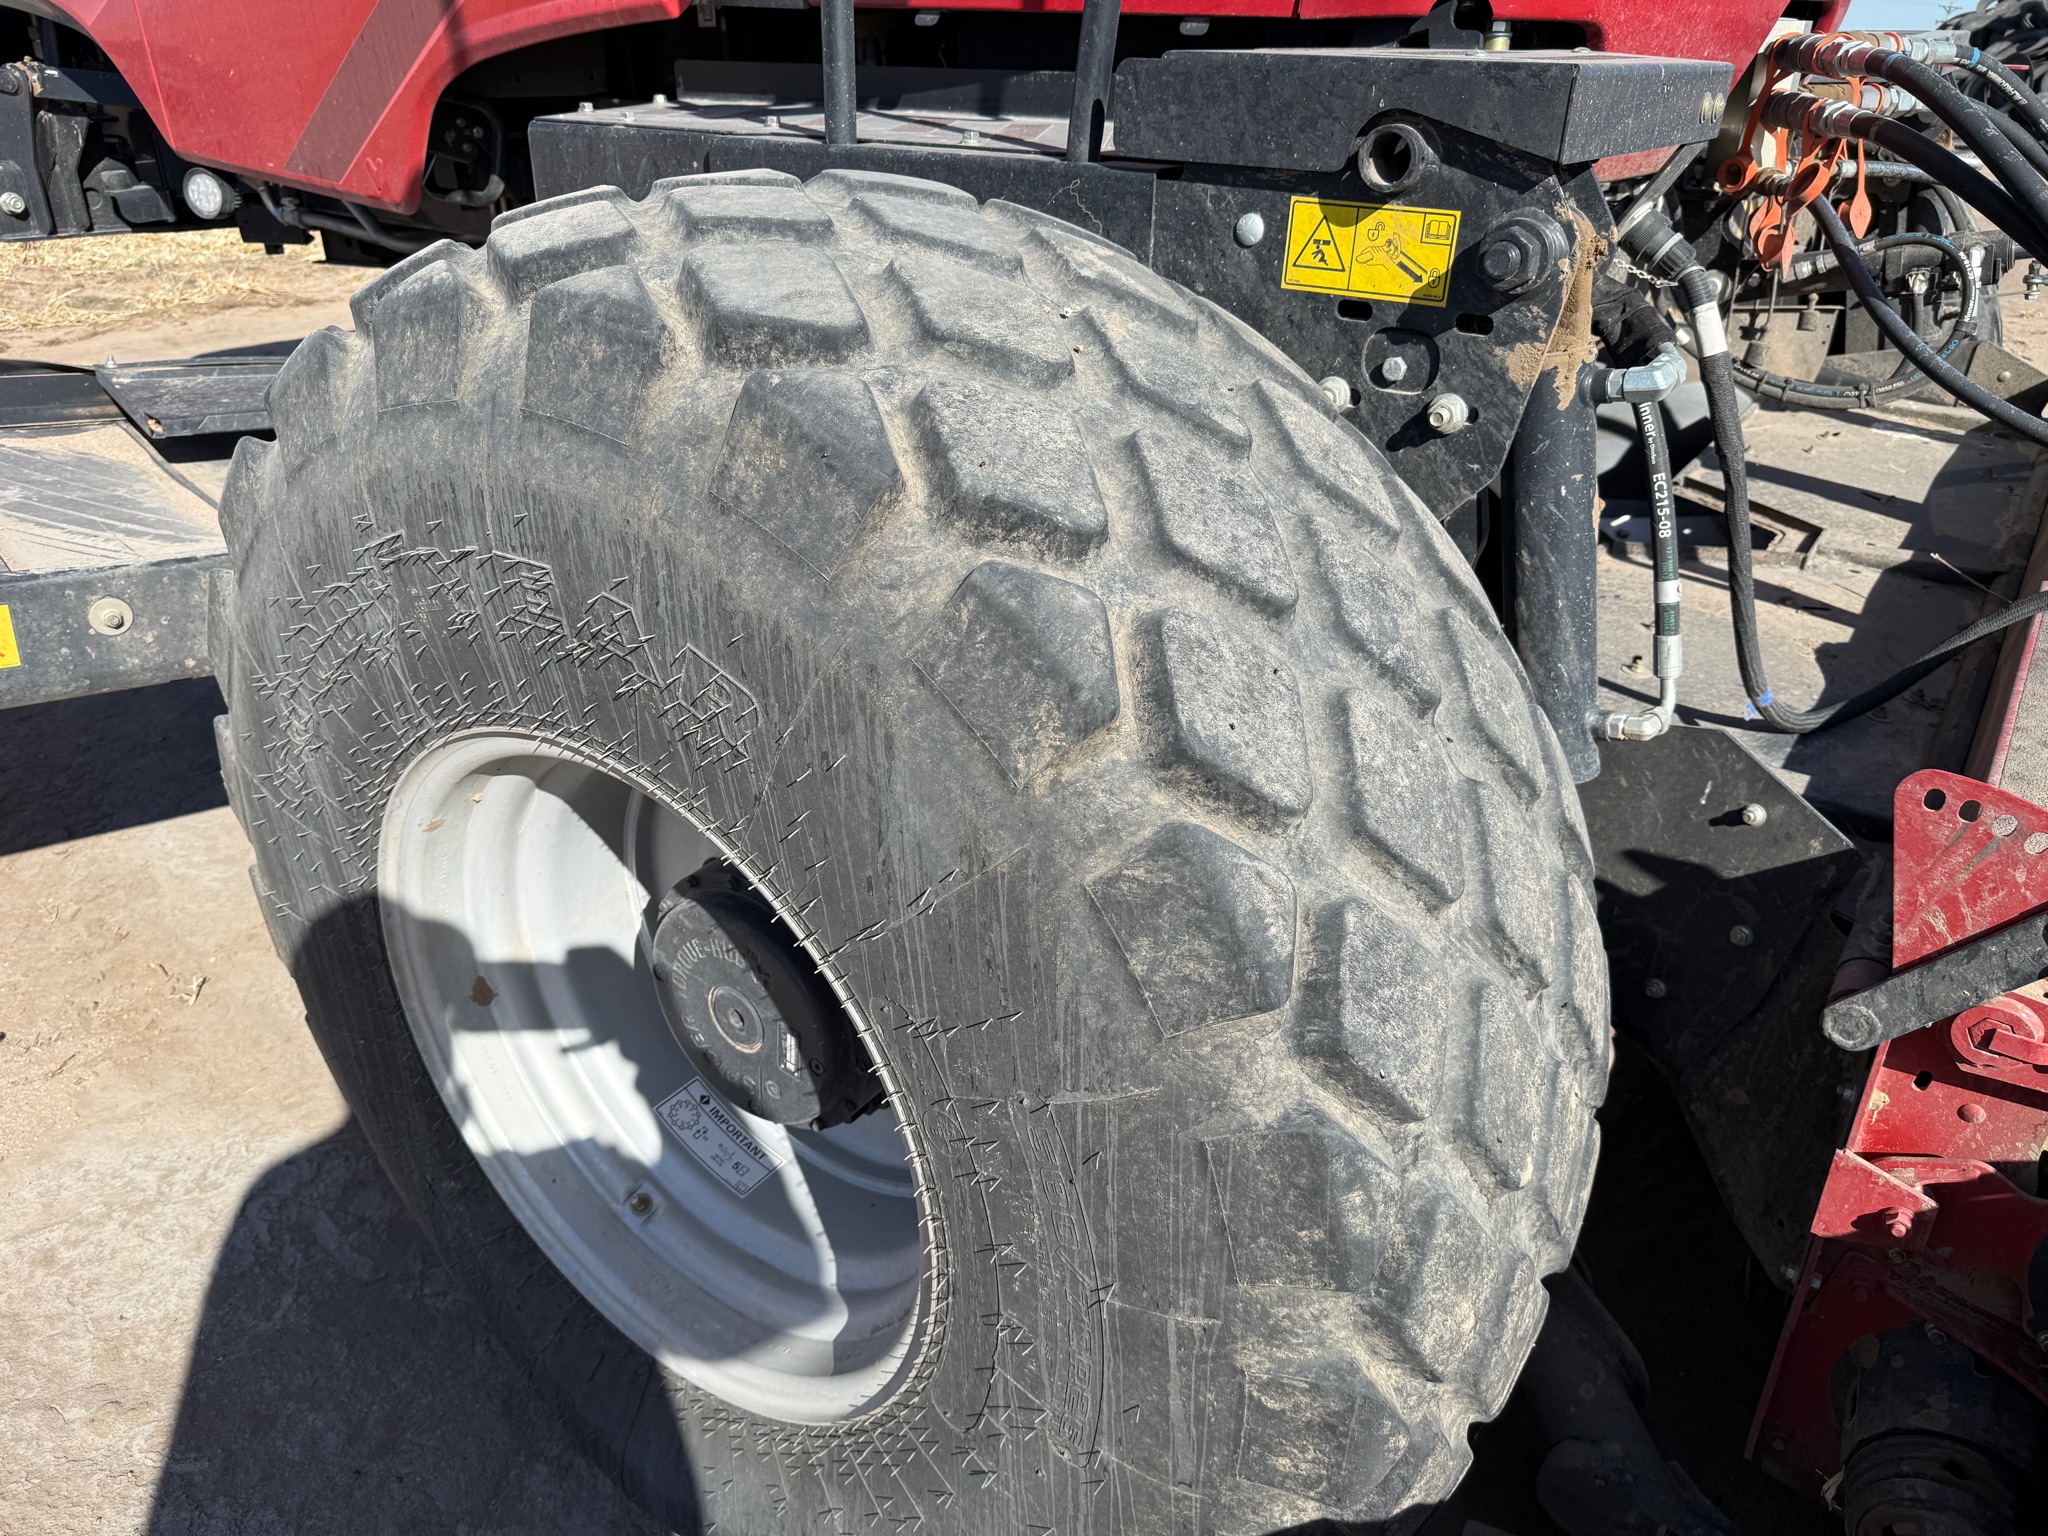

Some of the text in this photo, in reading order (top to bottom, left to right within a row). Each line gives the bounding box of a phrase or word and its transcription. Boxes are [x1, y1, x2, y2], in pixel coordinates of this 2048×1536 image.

[1638, 401, 1656, 437] inner
[1653, 472, 1672, 538] EC215-08
[709, 1106, 768, 1160] IMPORTANT
